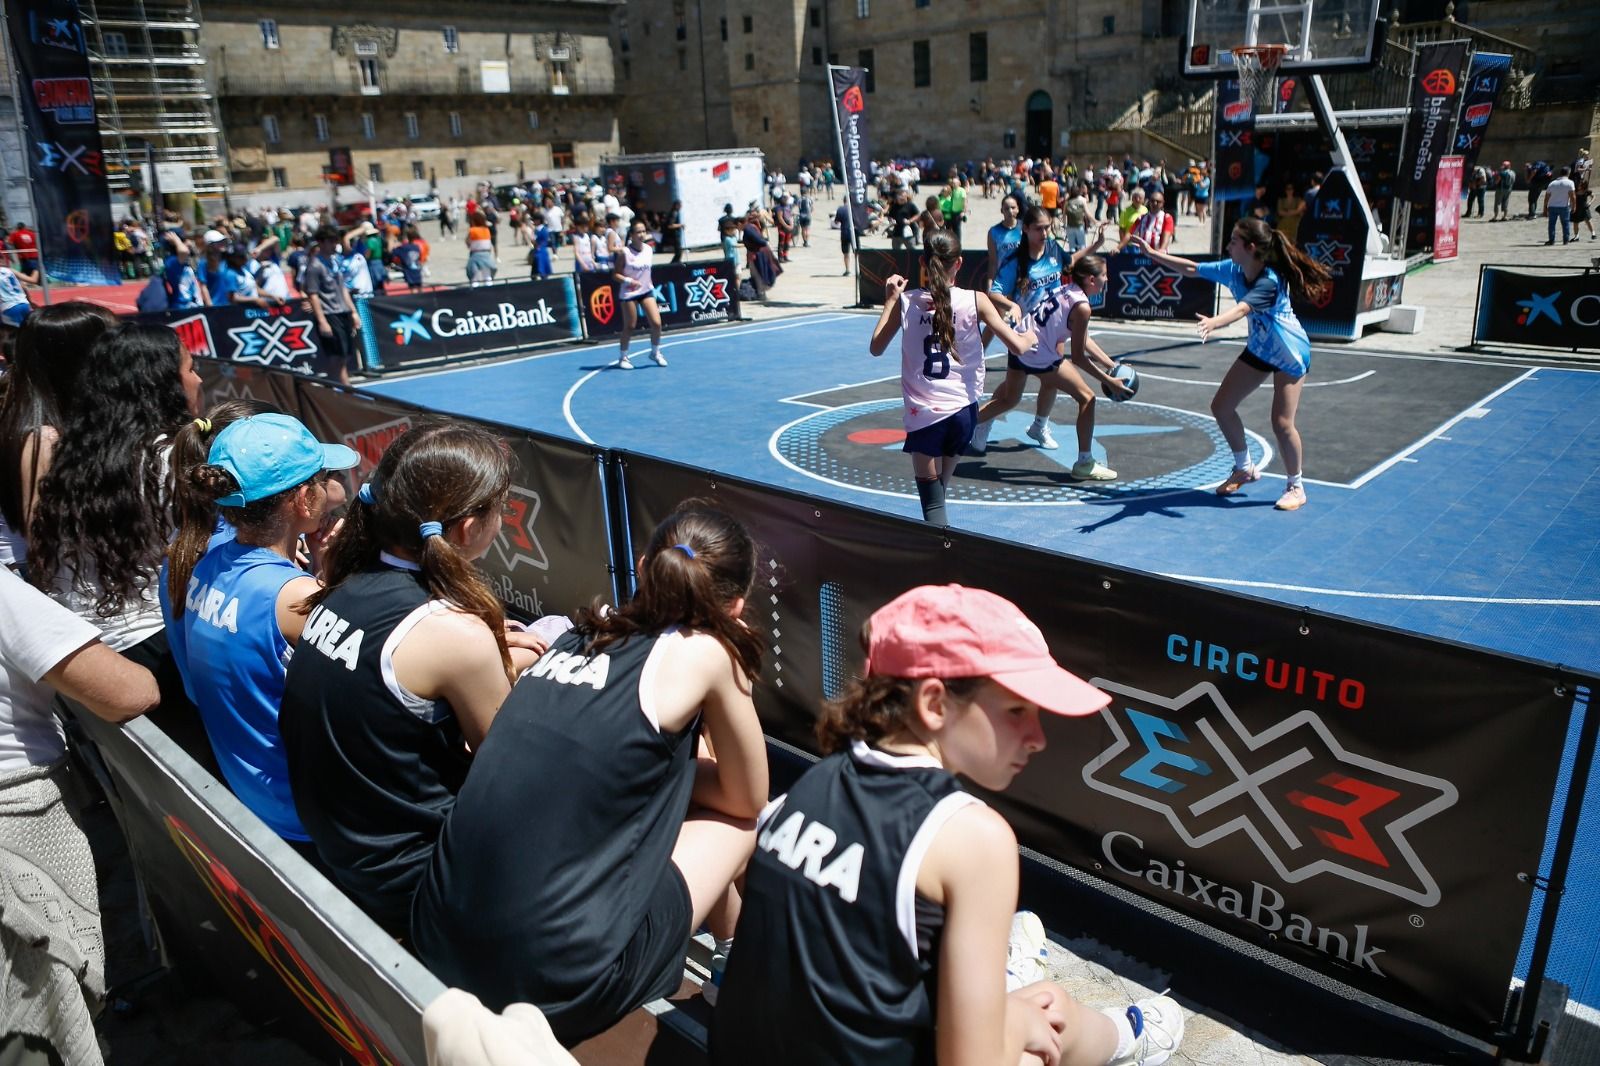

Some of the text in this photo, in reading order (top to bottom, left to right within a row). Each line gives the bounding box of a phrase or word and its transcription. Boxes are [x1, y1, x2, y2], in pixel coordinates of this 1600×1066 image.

[1413, 97, 1446, 180] baloncesto
[431, 298, 556, 337] CaixaBank
[692, 308, 729, 321] CaixaBank
[1122, 303, 1175, 318] CaixaBank
[922, 335, 950, 379] 8
[1166, 633, 1365, 710] CIRCUITO
[1100, 830, 1387, 978] CaixaBank
